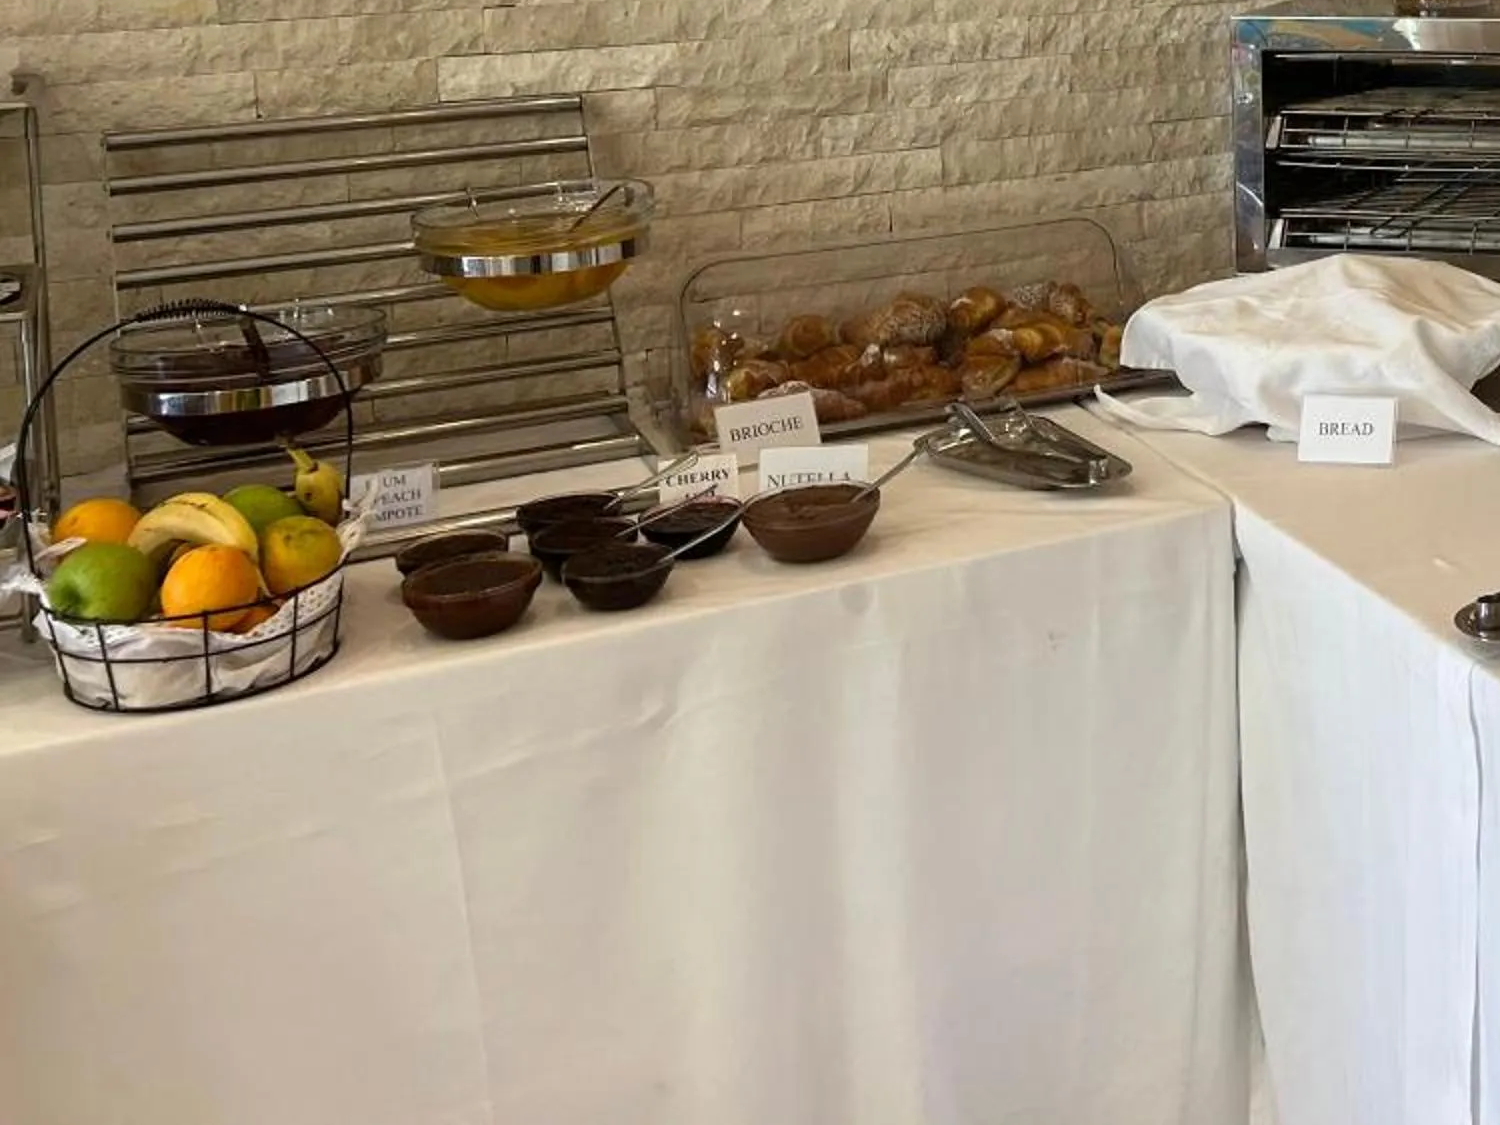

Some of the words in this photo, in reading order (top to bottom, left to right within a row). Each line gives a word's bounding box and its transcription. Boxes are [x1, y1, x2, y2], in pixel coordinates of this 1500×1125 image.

[729, 416, 802, 443] BRIOCHE
[1318, 422, 1375, 436] BREAD
[664, 468, 729, 487] CHERRY
